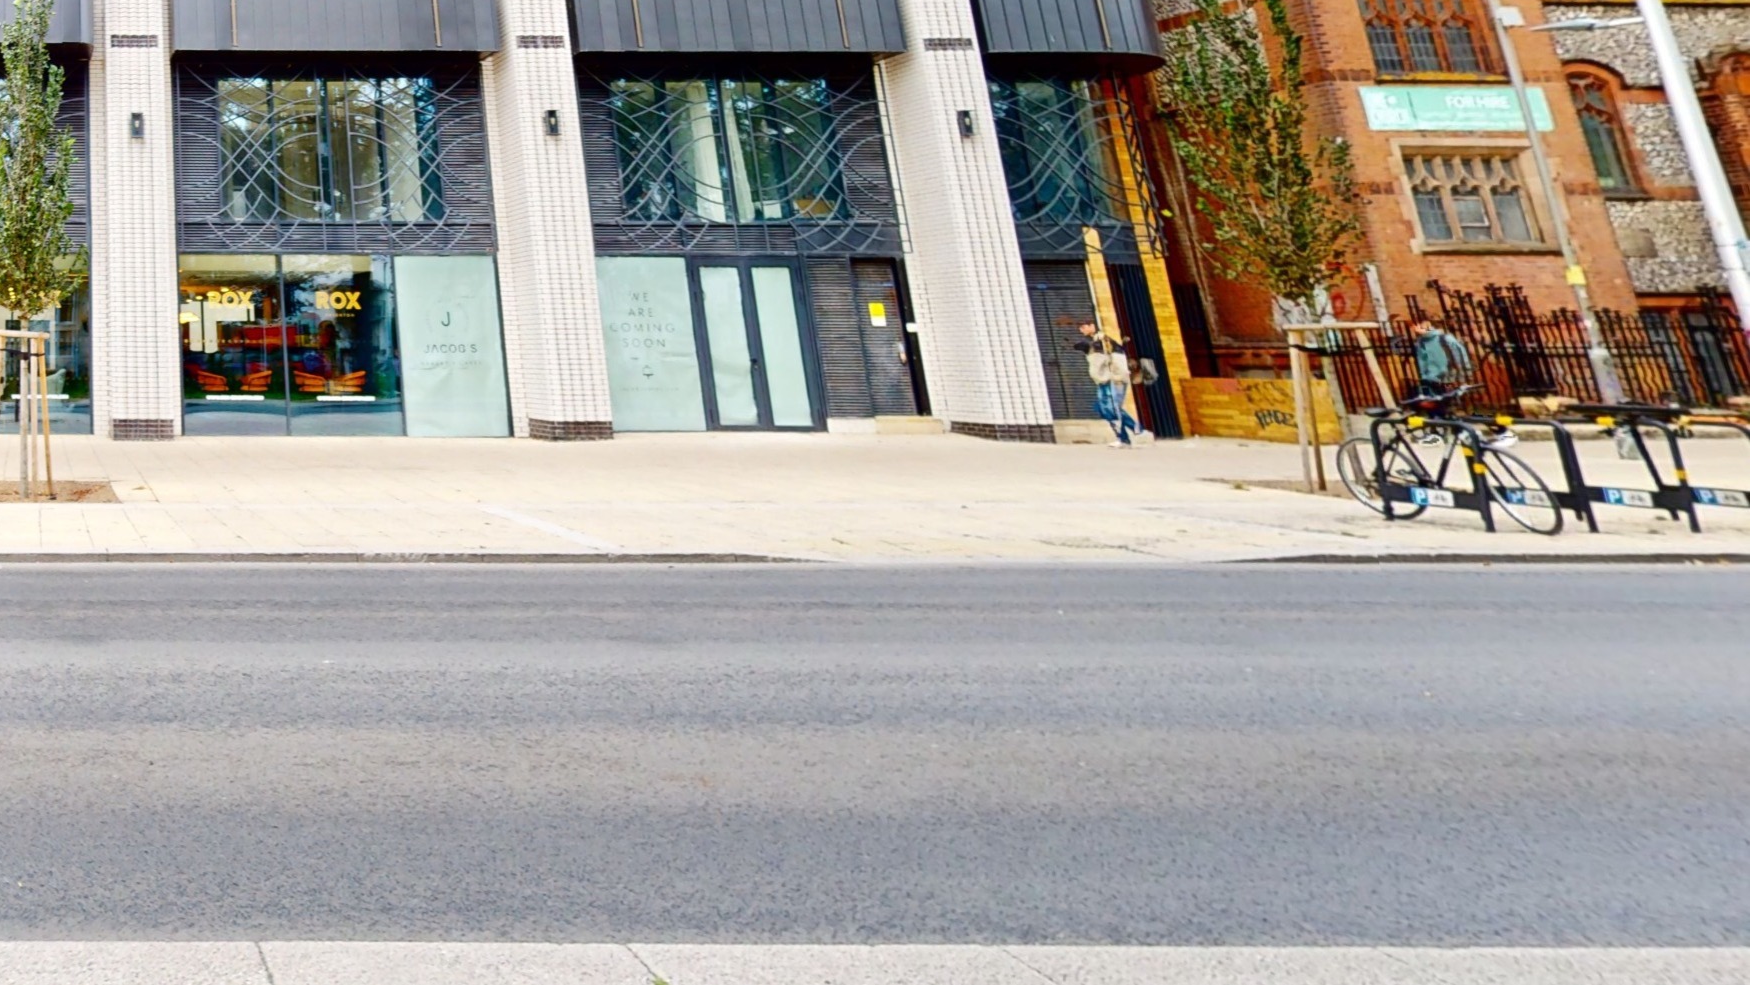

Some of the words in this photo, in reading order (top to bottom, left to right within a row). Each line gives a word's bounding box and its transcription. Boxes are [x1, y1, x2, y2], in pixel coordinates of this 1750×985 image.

[1445, 95, 1474, 109] FOR
[1477, 95, 1511, 109] HIRE
[207, 291, 253, 309] ROX
[315, 291, 362, 310] ROX
[441, 311, 451, 327] J
[628, 307, 655, 317] ARE
[610, 322, 675, 333] COMING
[424, 343, 478, 354] JACOBS
[622, 338, 666, 348] SOON
[1414, 488, 1427, 504] P
[1608, 489, 1621, 504] P
[1700, 489, 1713, 504] P
